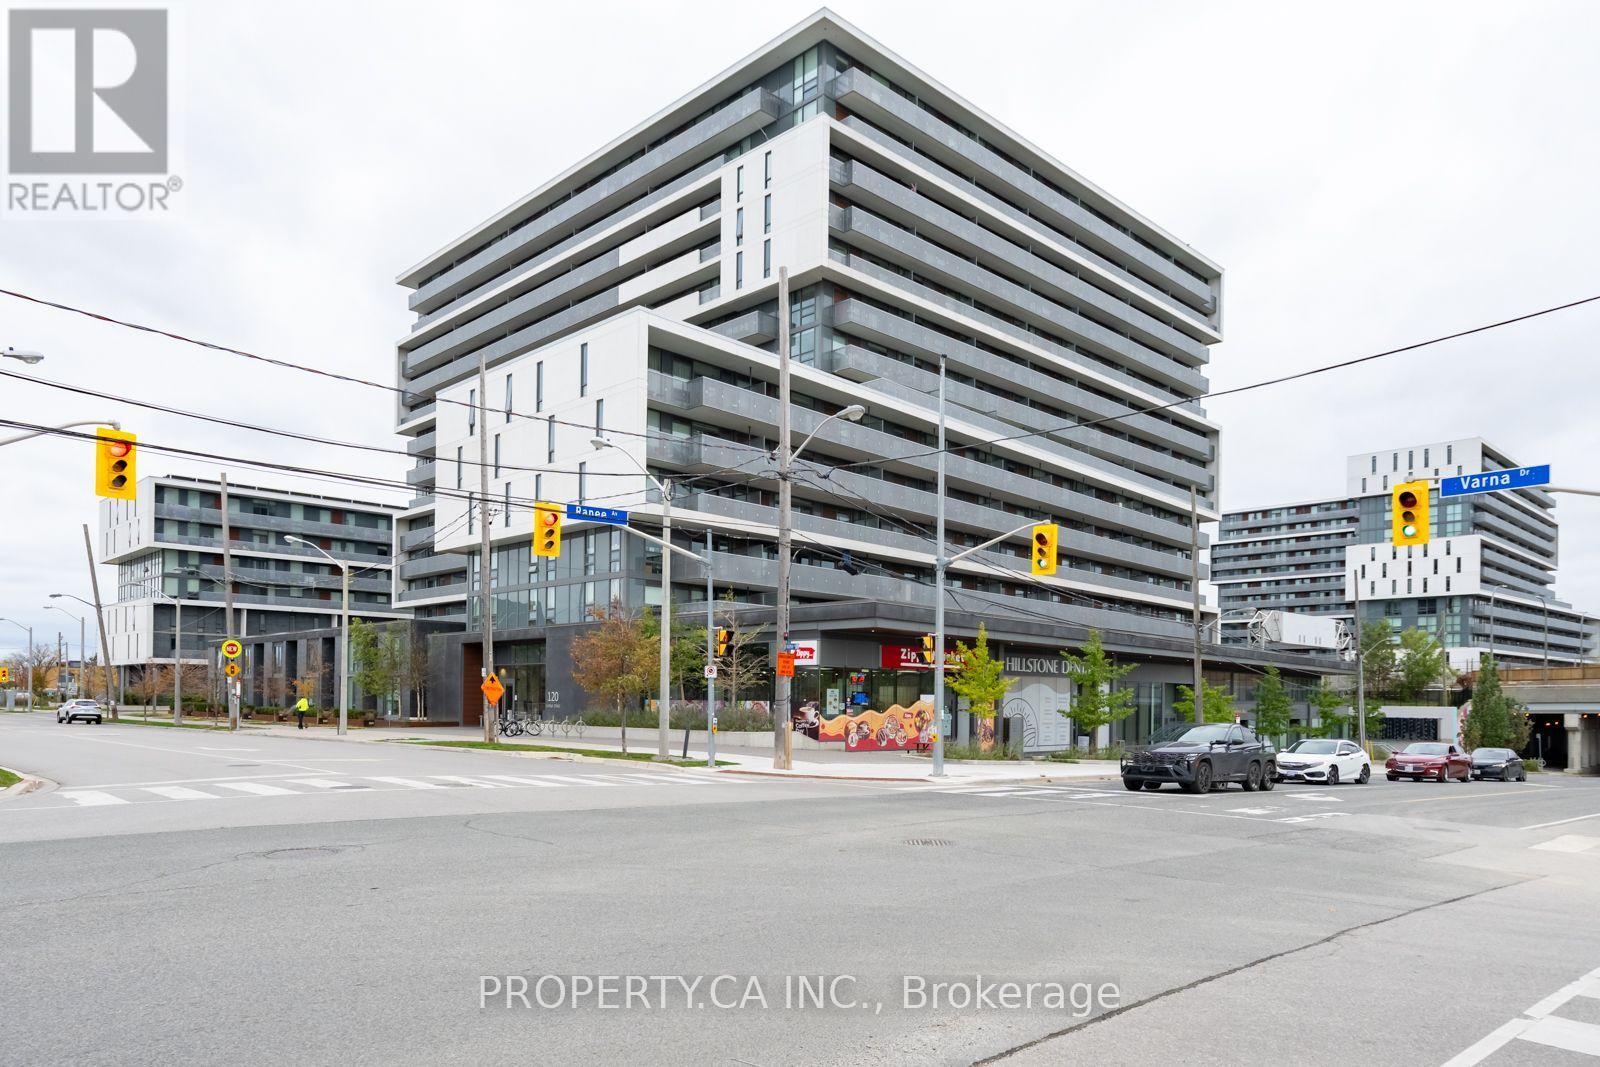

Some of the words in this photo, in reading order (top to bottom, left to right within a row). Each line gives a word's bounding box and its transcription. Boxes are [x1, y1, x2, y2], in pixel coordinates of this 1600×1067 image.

[1460, 473, 1511, 490] Varna
[1519, 468, 1531, 477] Dr
[1006, 656, 1059, 674] HILLSTONE
[547, 691, 559, 702] 120
